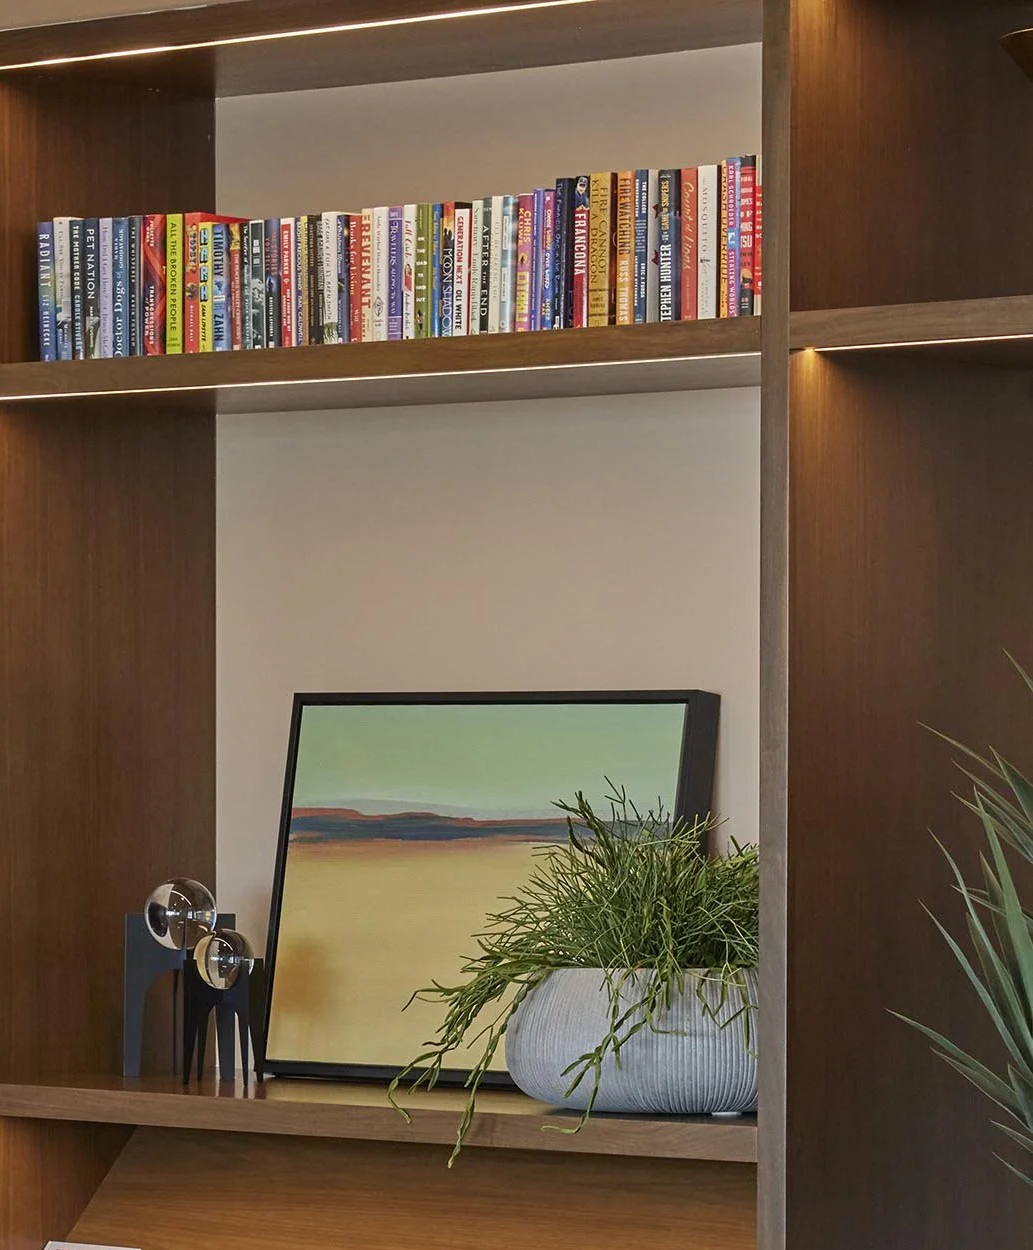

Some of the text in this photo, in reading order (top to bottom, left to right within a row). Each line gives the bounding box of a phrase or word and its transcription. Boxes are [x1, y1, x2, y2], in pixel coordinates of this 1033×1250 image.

[619, 178, 631, 255] FIREWATCHING
[661, 180, 670, 206] SNIPERS
[683, 182, 694, 222] Court
[40, 234, 50, 287] RADIANT
[213, 230, 224, 277] TIMOTHY
[574, 214, 586, 275] FRANCONA
[598, 188, 608, 276] FIRE CANNOT
[683, 236, 694, 269] Lions
[87, 254, 95, 299] NATION
[362, 223, 371, 308] REVENANT
[442, 248, 453, 336] MOON SHADOW
[619, 260, 629, 321] RUSS THOMAS
[660, 244, 671, 322] TEPHEN HUNTER
[114, 281, 125, 357] Doctor Dogs
[214, 314, 224, 341] ZAHN
